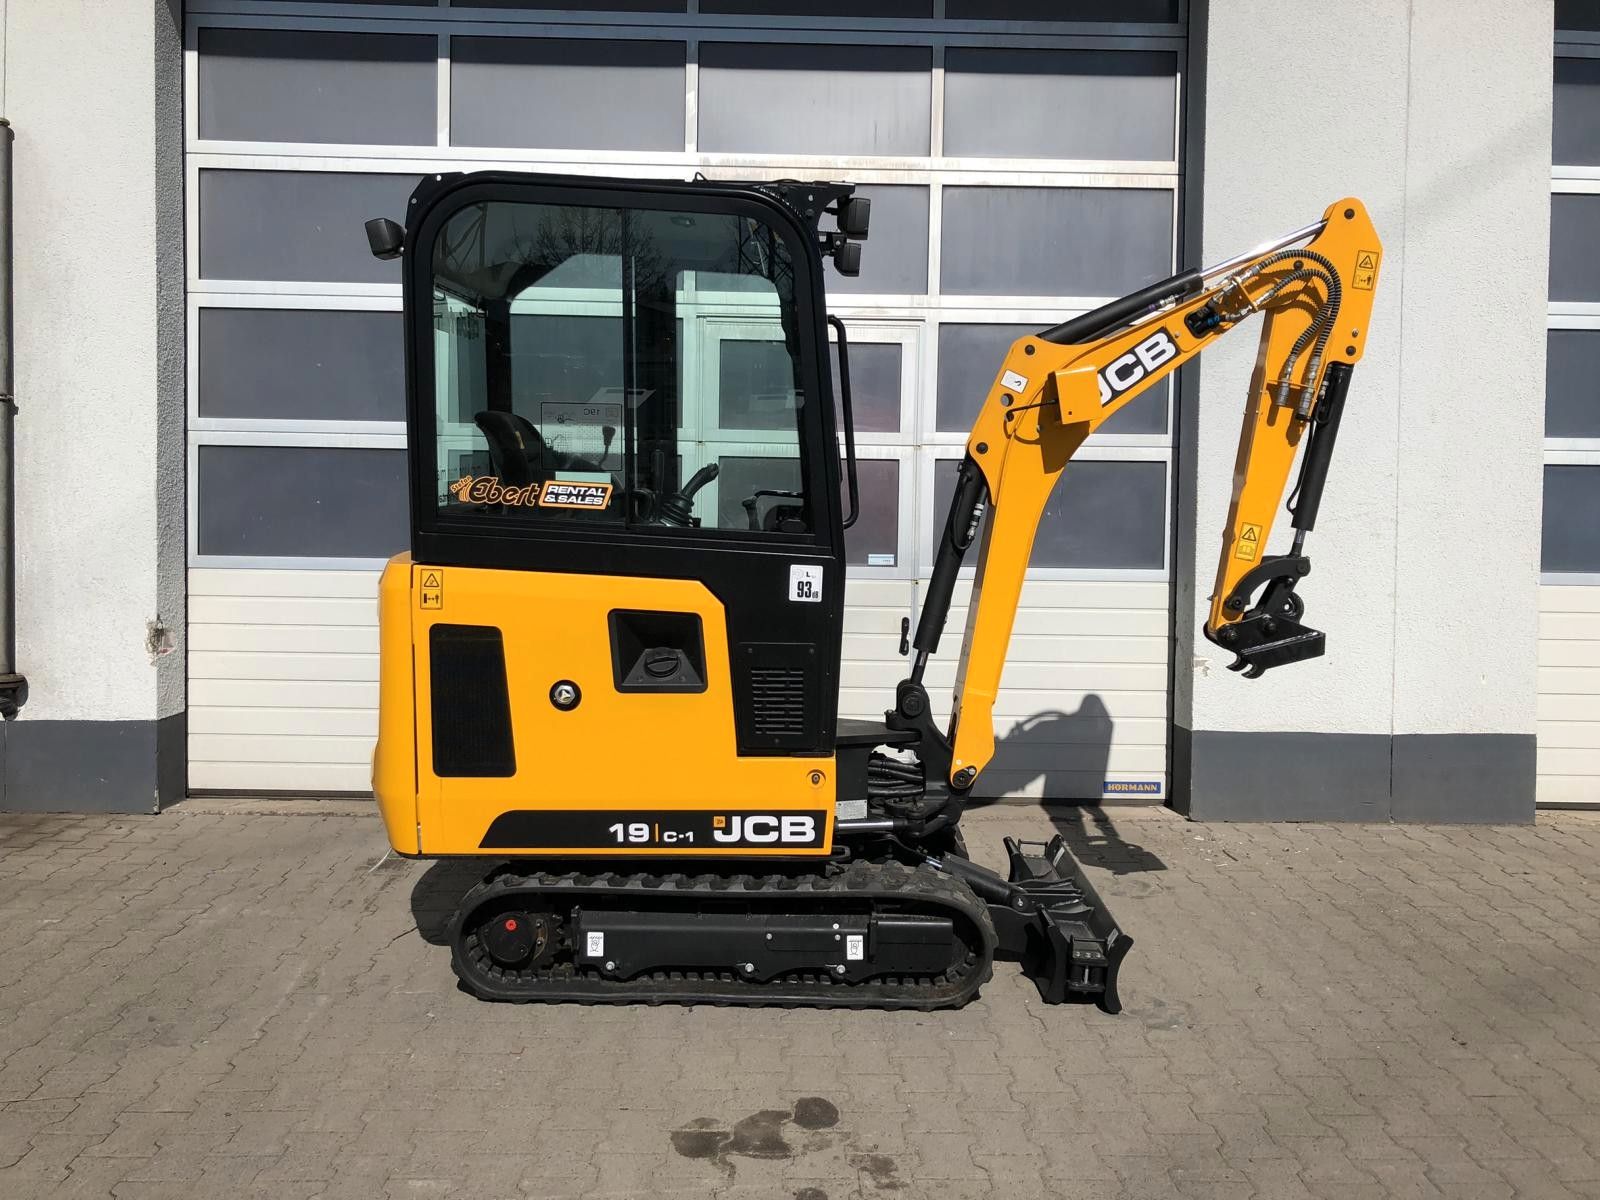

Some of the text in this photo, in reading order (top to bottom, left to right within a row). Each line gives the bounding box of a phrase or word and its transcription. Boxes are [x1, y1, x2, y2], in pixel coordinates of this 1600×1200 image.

[468, 476, 540, 506] Ebert
[545, 495, 604, 505] & SALES
[548, 485, 605, 496] RENTAL
[609, 823, 649, 843] 19
[713, 815, 816, 843] JCB
